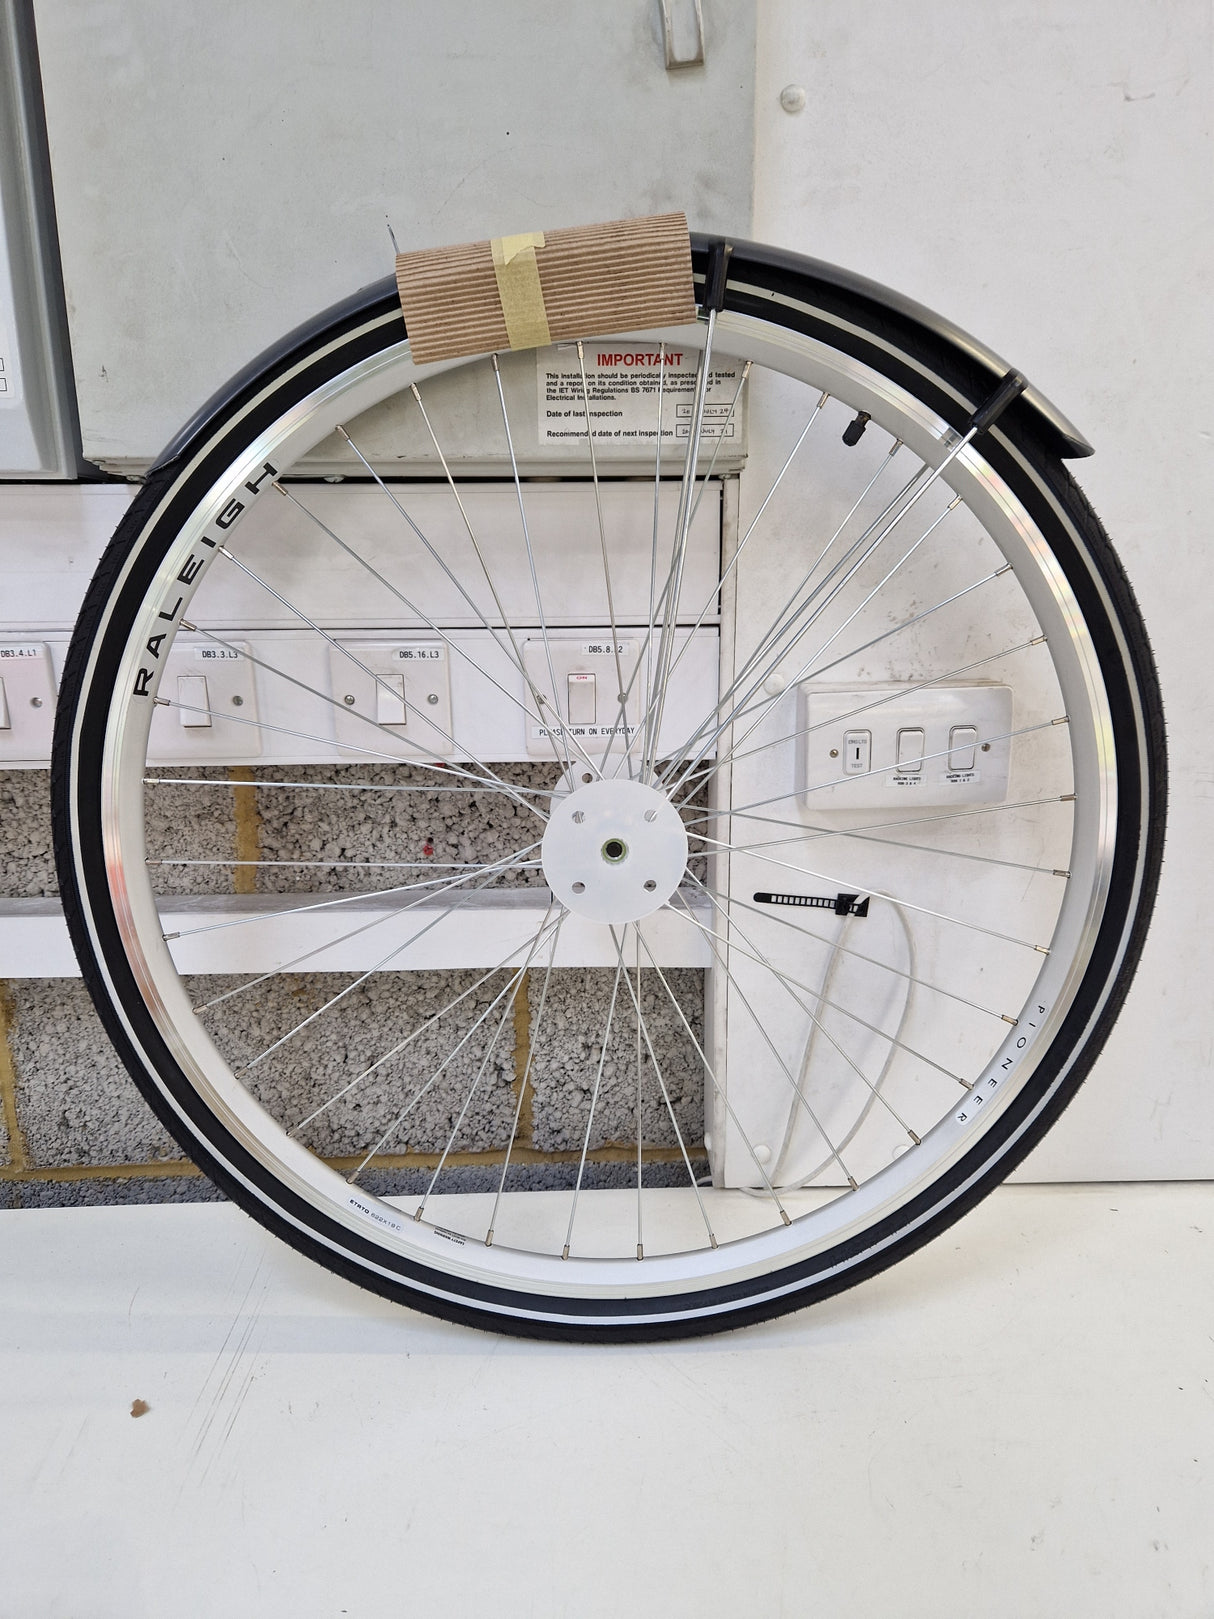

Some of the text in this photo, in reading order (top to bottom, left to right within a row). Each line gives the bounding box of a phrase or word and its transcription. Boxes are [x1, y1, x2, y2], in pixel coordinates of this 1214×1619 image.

[597, 353, 683, 366] IMPORTANT
[630, 372, 666, 380] periodicaly
[133, 462, 277, 696] RALEIGH
[0, 649, 37, 658] DB3.4.L1
[588, 646, 624, 654] DB5.8.2
[957, 1005, 1045, 1122] PIONEER
